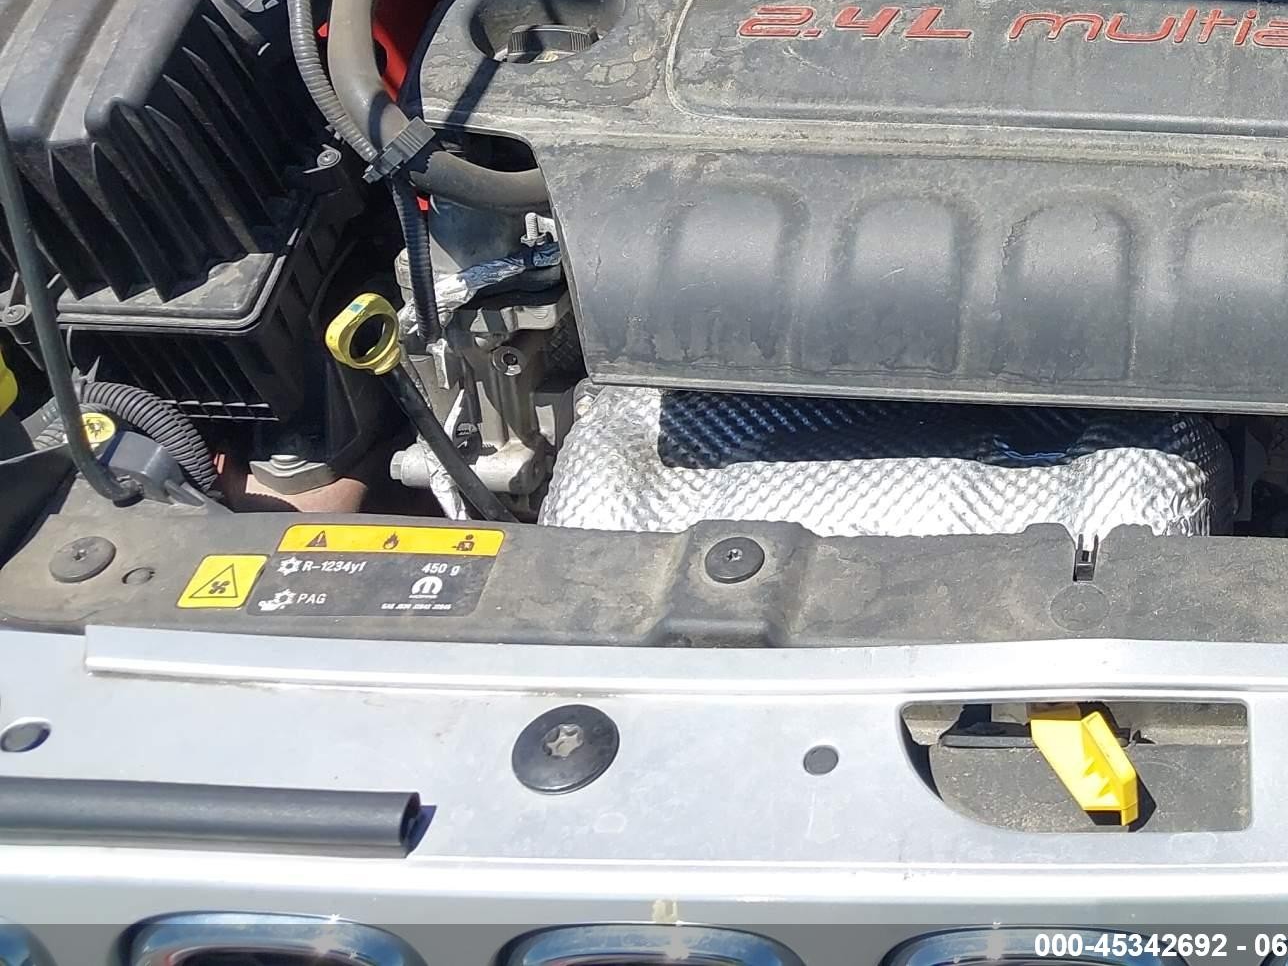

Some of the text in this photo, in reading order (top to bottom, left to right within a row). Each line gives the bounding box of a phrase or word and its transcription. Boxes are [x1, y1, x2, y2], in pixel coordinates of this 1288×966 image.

[737, 5, 973, 40] 2.4L
[421, 562, 448, 574] 450
[449, 565, 462, 577] g
[296, 593, 328, 604] PAG
